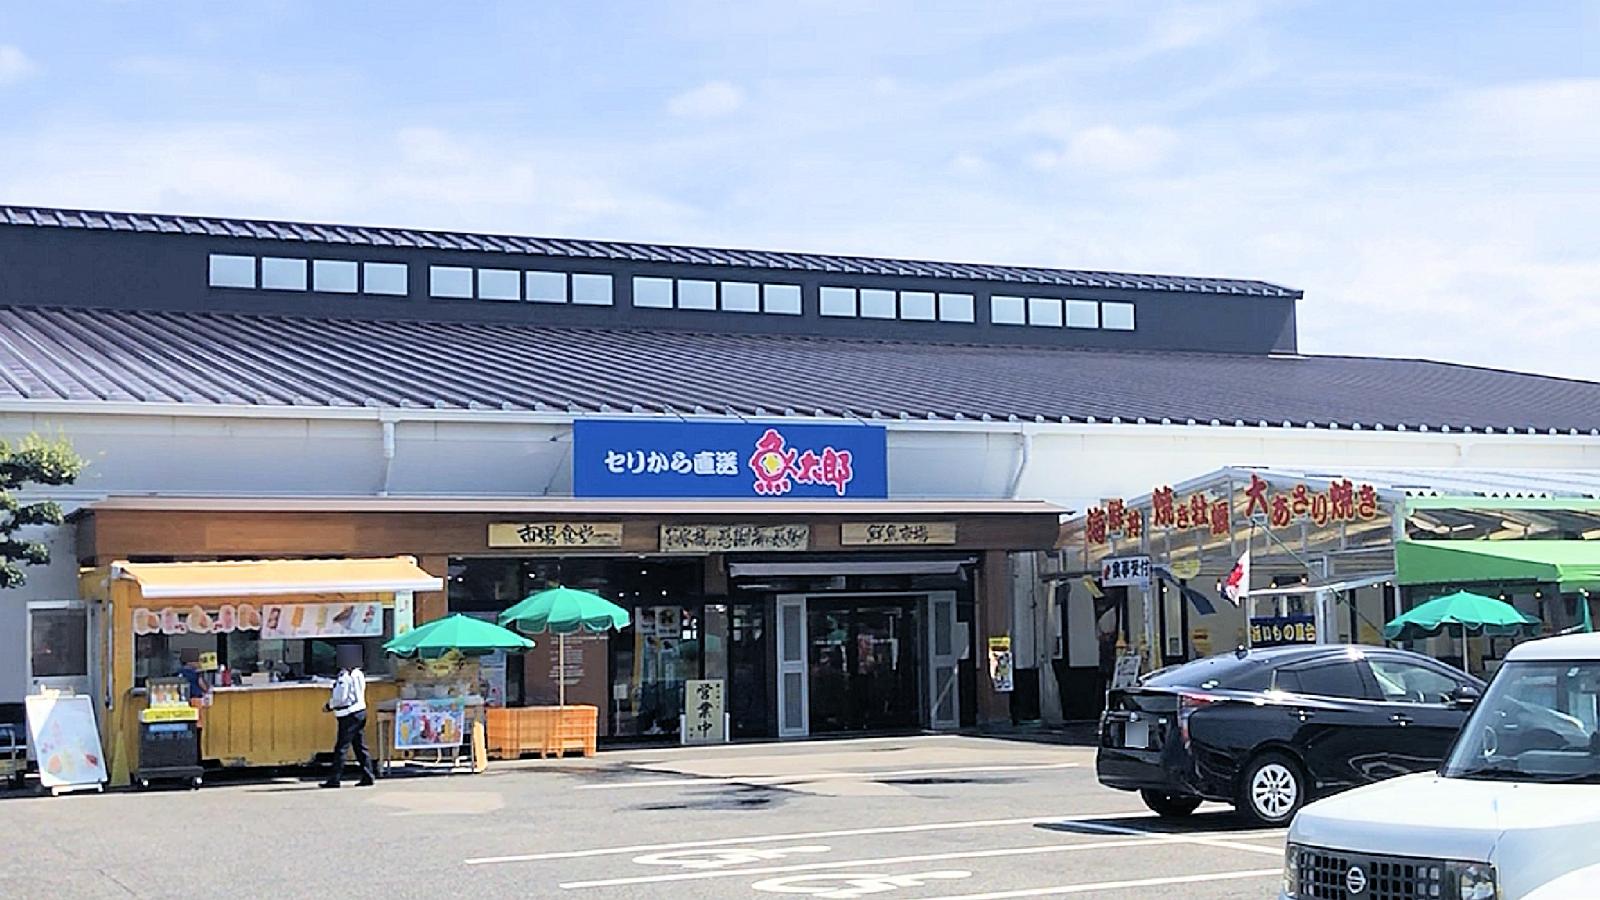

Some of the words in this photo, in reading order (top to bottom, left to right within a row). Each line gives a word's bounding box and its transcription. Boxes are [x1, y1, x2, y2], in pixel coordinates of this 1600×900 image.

[604, 450, 739, 475] セリから直送
[749, 427, 854, 496] 魚太郎
[1244, 474, 1378, 528] 大あさり焼き
[696, 683, 714, 739] 営業中
